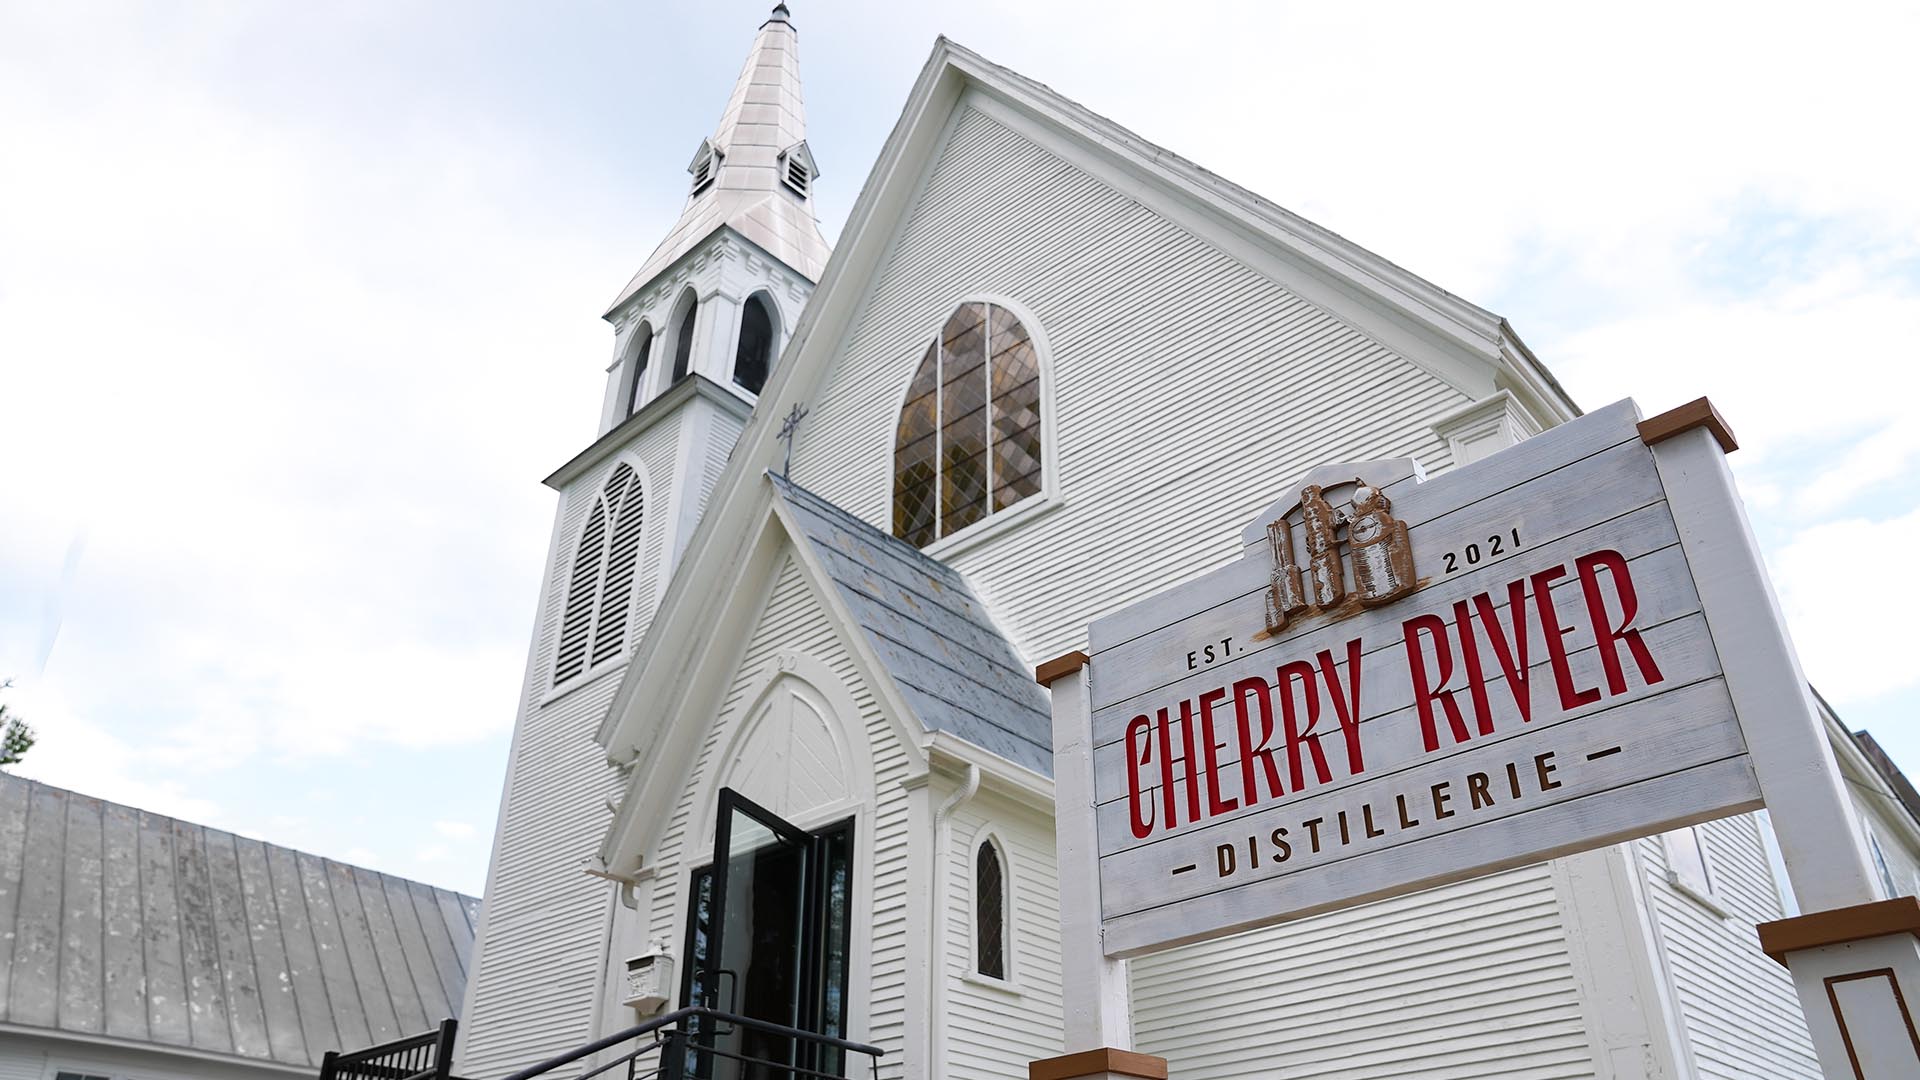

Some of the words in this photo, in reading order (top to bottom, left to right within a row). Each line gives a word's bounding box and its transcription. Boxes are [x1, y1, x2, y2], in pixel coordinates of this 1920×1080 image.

[1187, 637, 1244, 671] EST.
[1443, 527, 1522, 575] 2021
[1124, 637, 1365, 840] CHERRY
[1402, 548, 1664, 754] RIVER
[1217, 751, 1563, 878] DISTILLERIE
